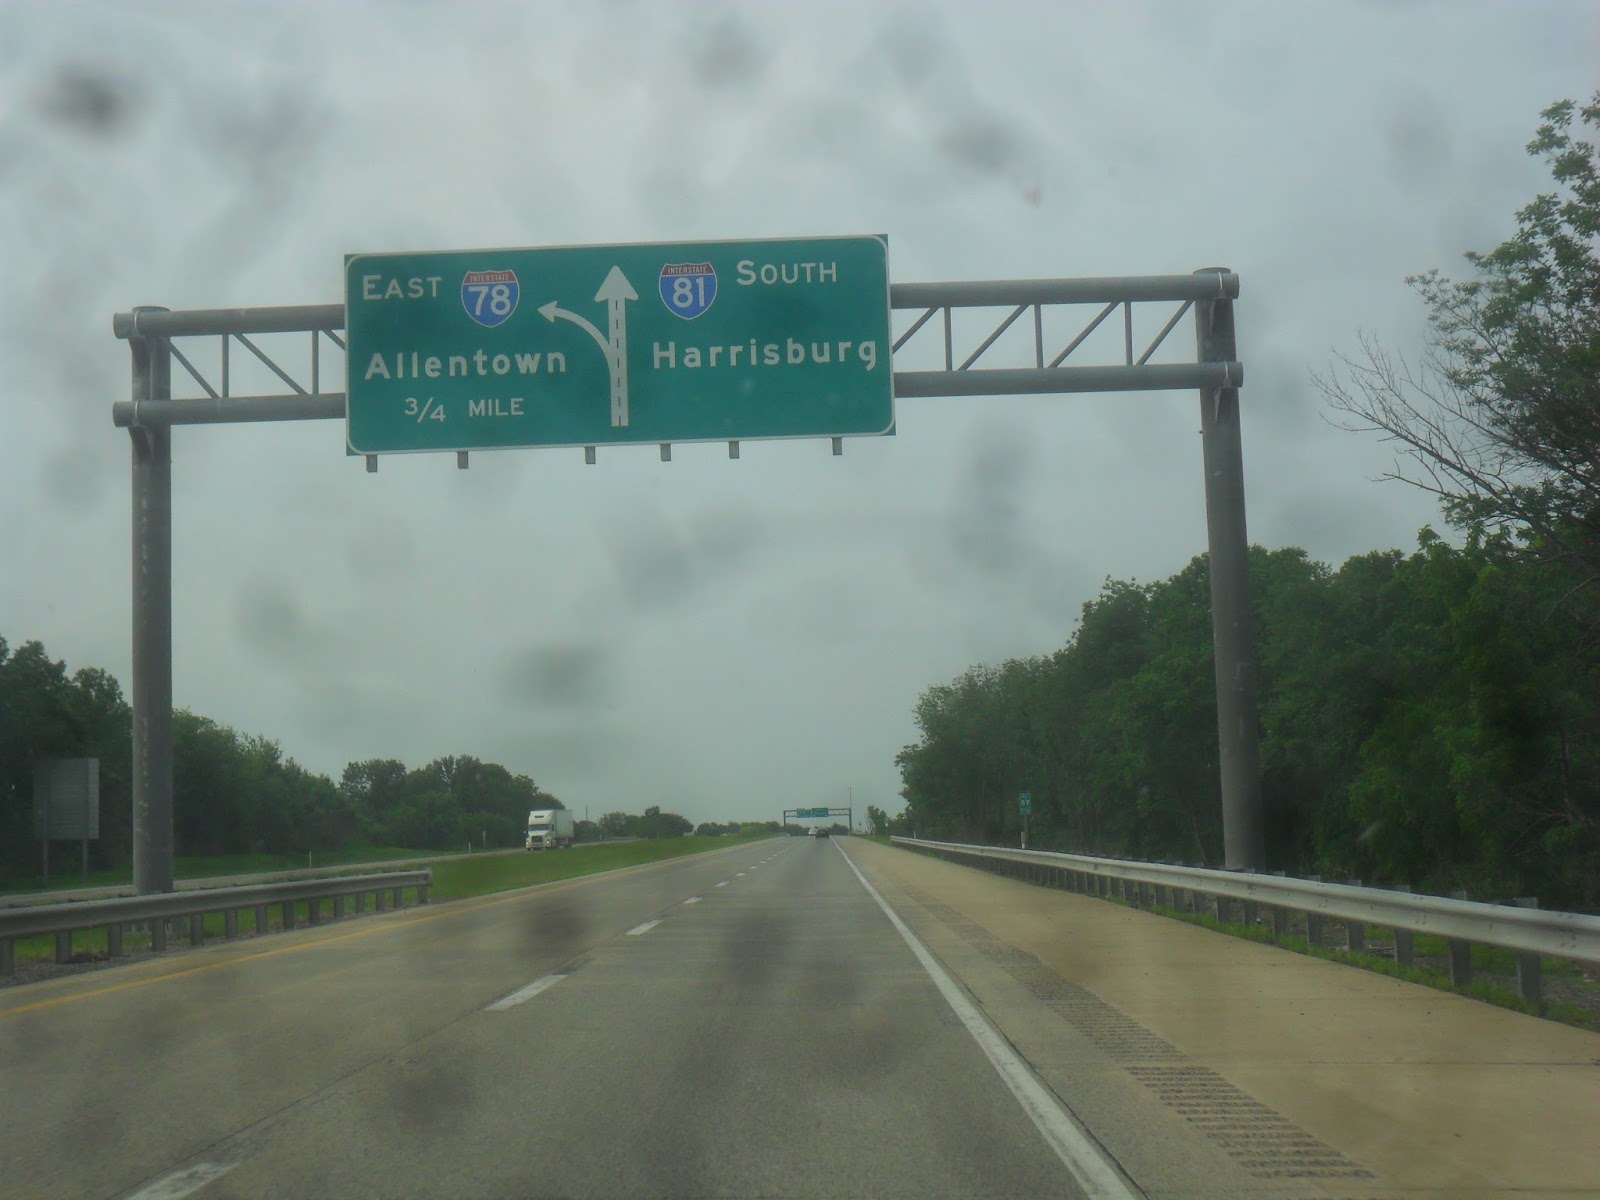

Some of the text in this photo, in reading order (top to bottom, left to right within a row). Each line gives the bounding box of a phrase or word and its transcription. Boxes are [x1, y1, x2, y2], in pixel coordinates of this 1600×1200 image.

[470, 274, 510, 283] INTERSTATE
[667, 266, 708, 275] INTERSTATE
[736, 260, 837, 285] SOUTH
[363, 275, 442, 300] EAST
[468, 284, 510, 316] 78
[673, 277, 705, 308] 81
[364, 349, 566, 380] Allentown
[653, 338, 876, 371] Harrisburg
[405, 397, 524, 423] 3/4 MILE
